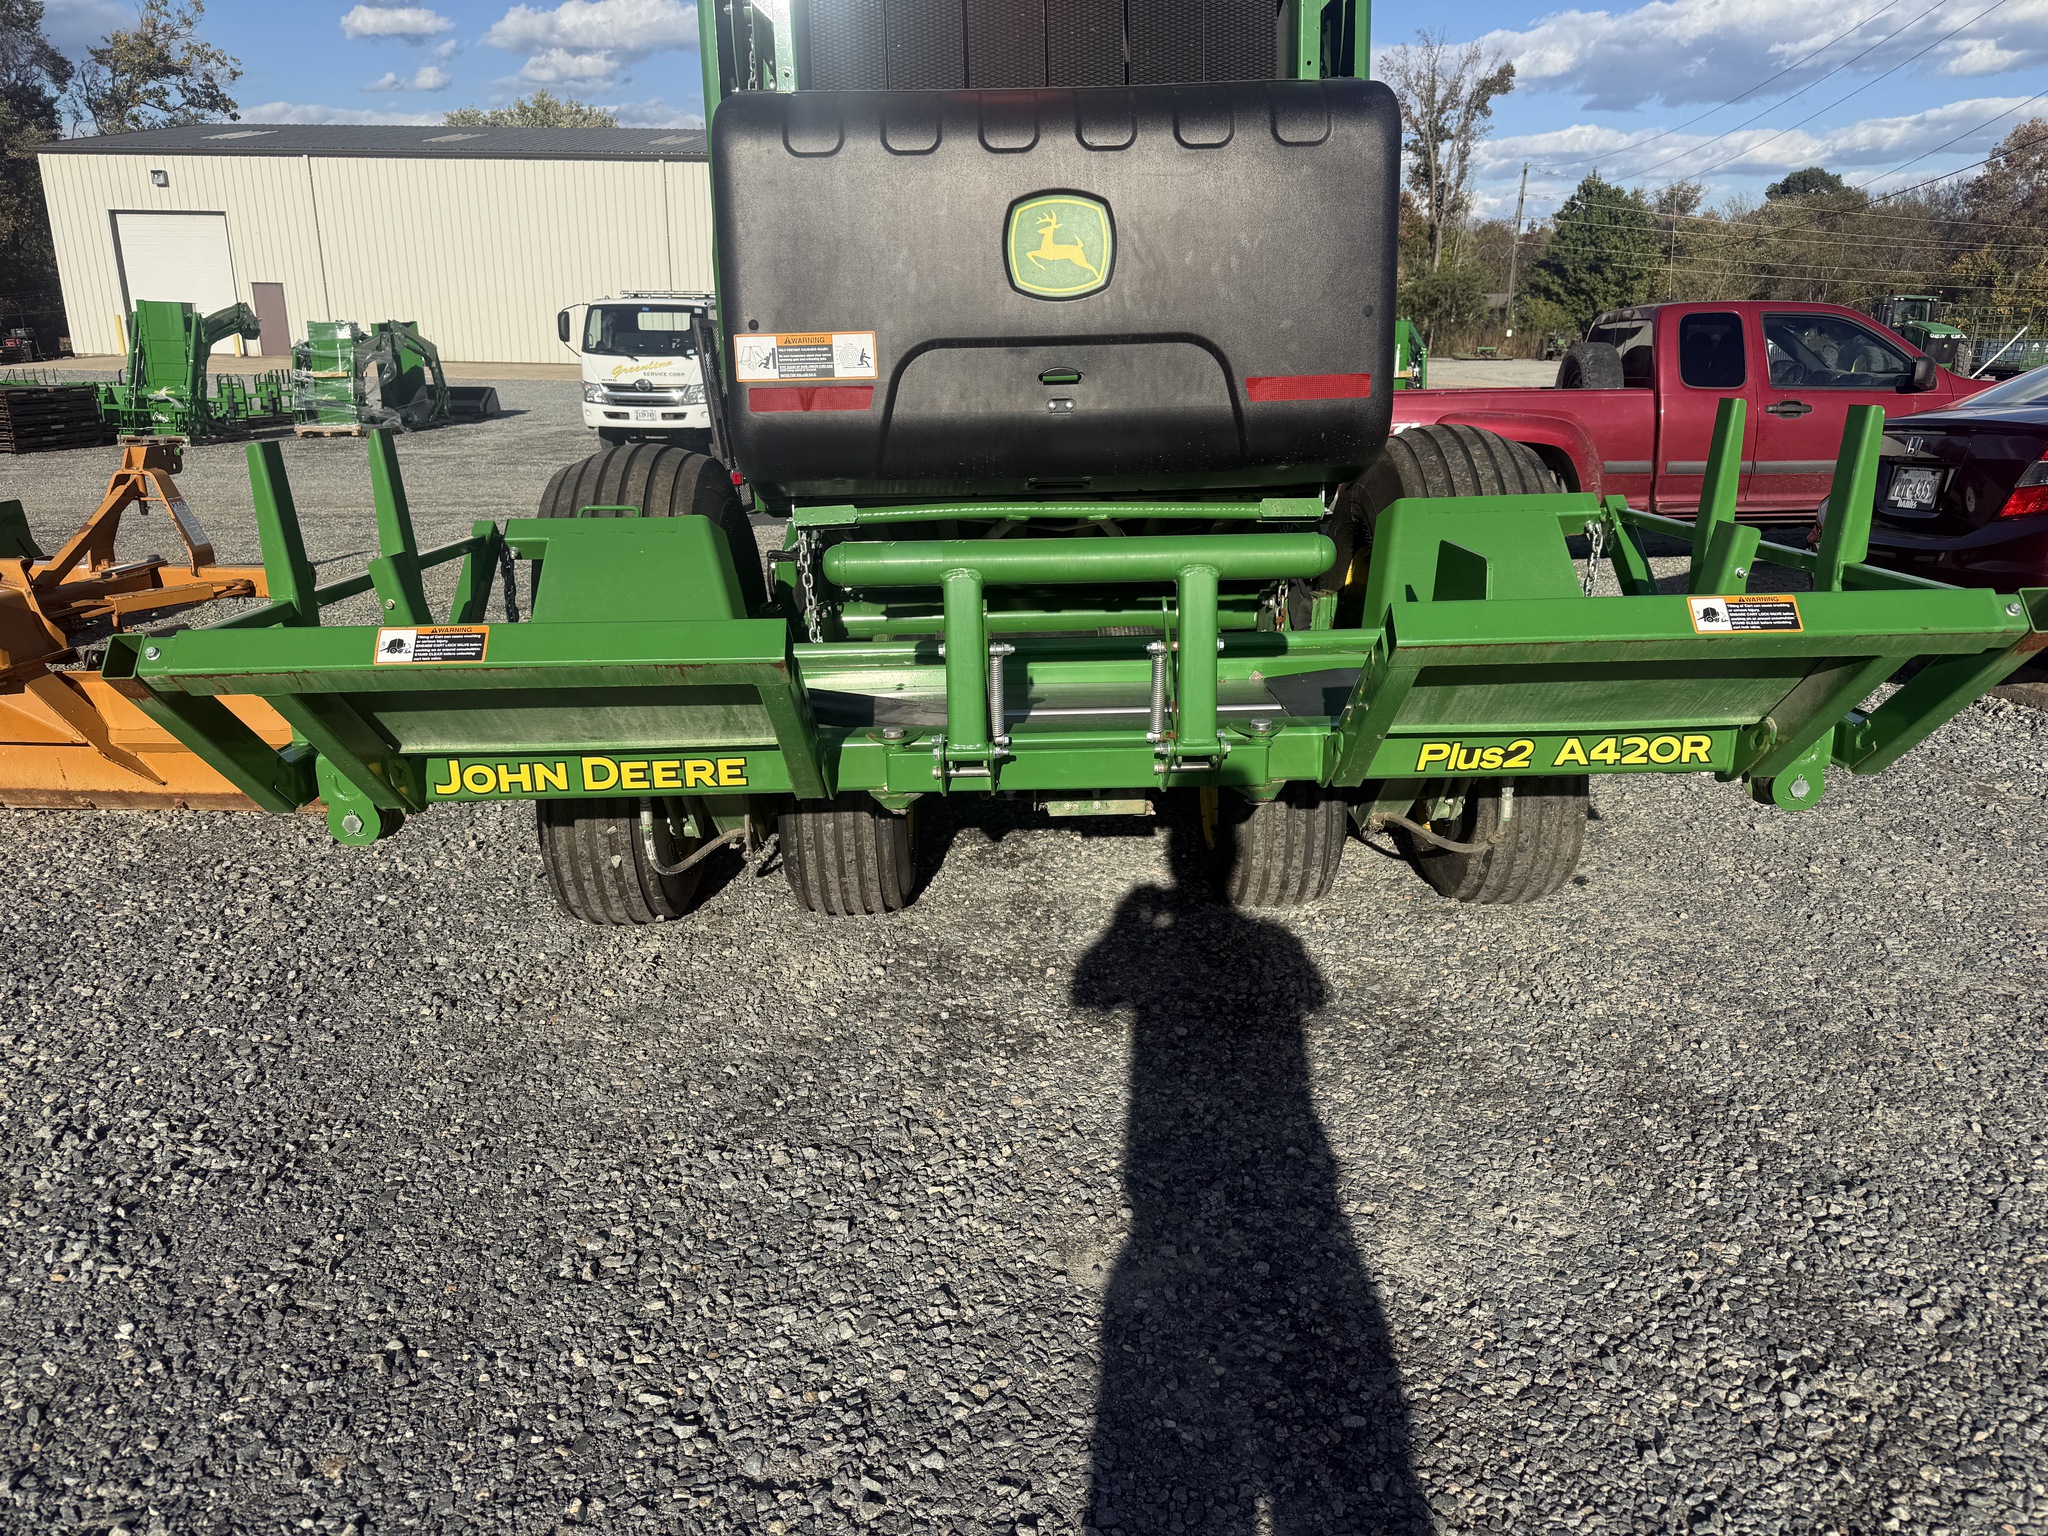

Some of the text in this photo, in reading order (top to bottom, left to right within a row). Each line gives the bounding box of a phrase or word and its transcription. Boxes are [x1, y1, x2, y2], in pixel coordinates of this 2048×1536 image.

[611, 360, 673, 379] Greenline
[1414, 734, 1713, 772] Plus2 A420R
[434, 756, 748, 794] JOHN DEERE
